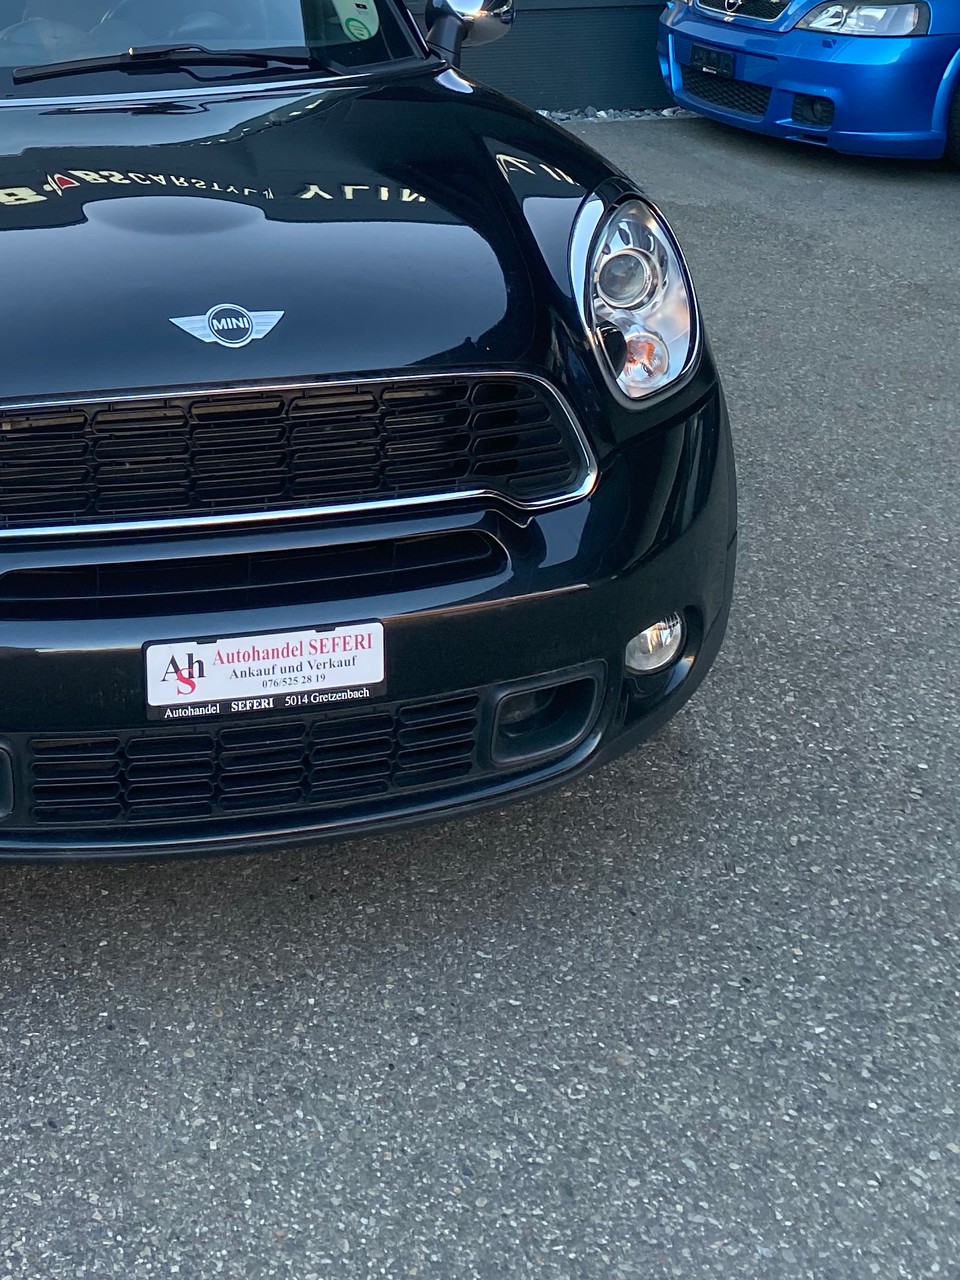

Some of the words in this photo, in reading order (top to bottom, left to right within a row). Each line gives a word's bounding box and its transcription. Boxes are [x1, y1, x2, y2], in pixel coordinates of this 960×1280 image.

[212, 317, 249, 330] MINI
[213, 640, 303, 666] Autohandel
[308, 633, 373, 656] SEFERI
[229, 664, 277, 679] Ankauf
[280, 661, 303, 675] und
[307, 655, 357, 671] Verkauf
[262, 676, 299, 688] 076/525
[302, 675, 312, 684] 28
[316, 673, 326, 683] 19
[164, 703, 220, 718] Autohandel
[230, 698, 274, 712] SEFERI
[284, 694, 309, 706] 5014
[310, 687, 370, 703] Gretzenbach
